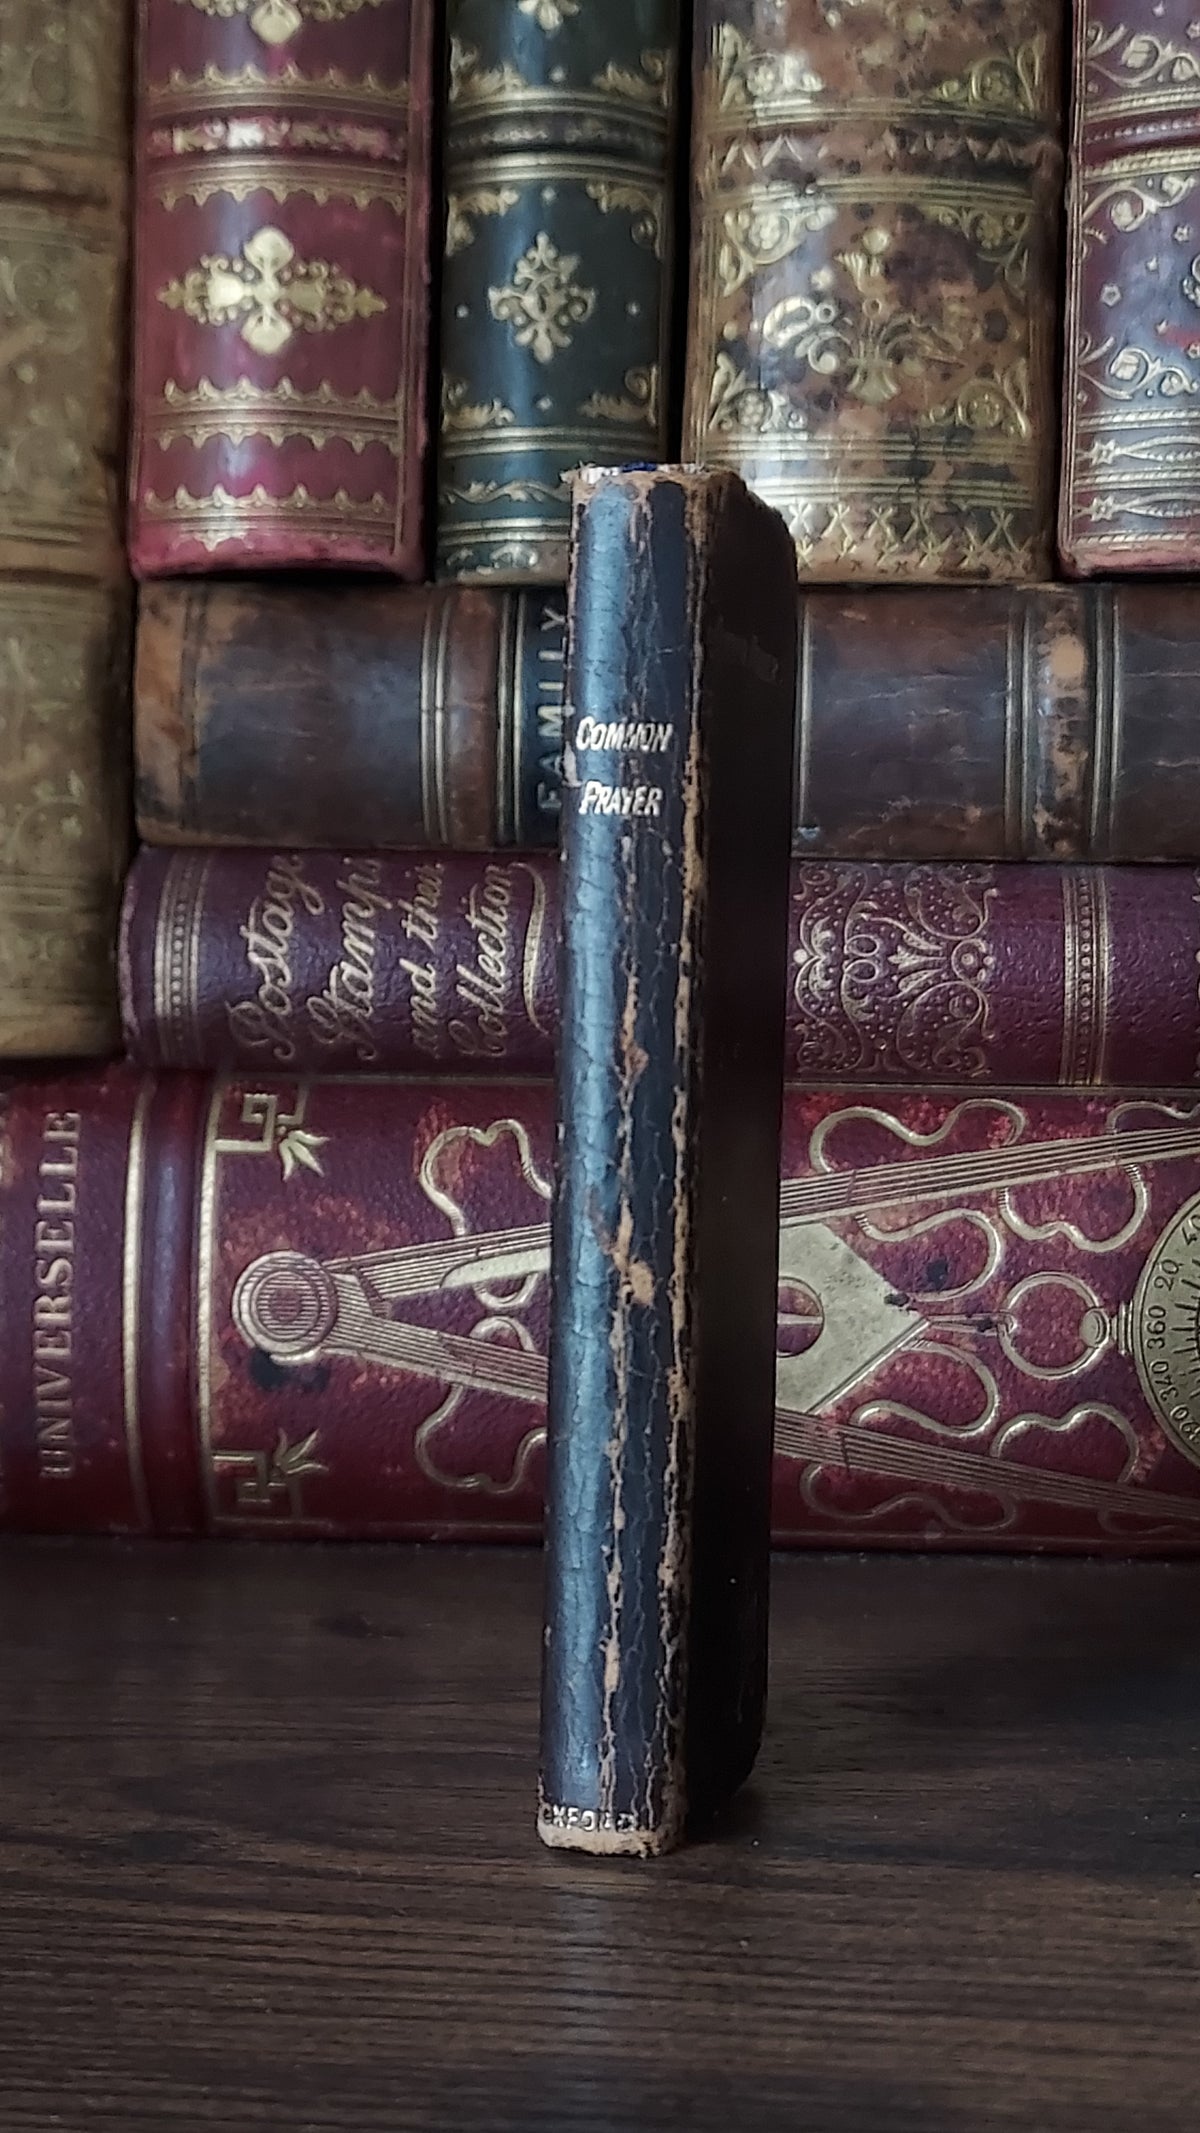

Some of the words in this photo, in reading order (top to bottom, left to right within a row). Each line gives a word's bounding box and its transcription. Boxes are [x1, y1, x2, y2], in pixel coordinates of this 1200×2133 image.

[537, 608, 568, 809] FAMILY
[575, 715, 674, 753] COMMON
[578, 779, 664, 817] PRAYER
[306, 856, 393, 1061] Stamps
[448, 862, 513, 1057] Collection
[399, 961, 442, 1060] and
[33, 1111, 82, 1479] UNIVERSELLE
[1153, 1257, 1182, 1292] 20
[1147, 1304, 1168, 1351] 360
[1151, 1360, 1180, 1402] 340
